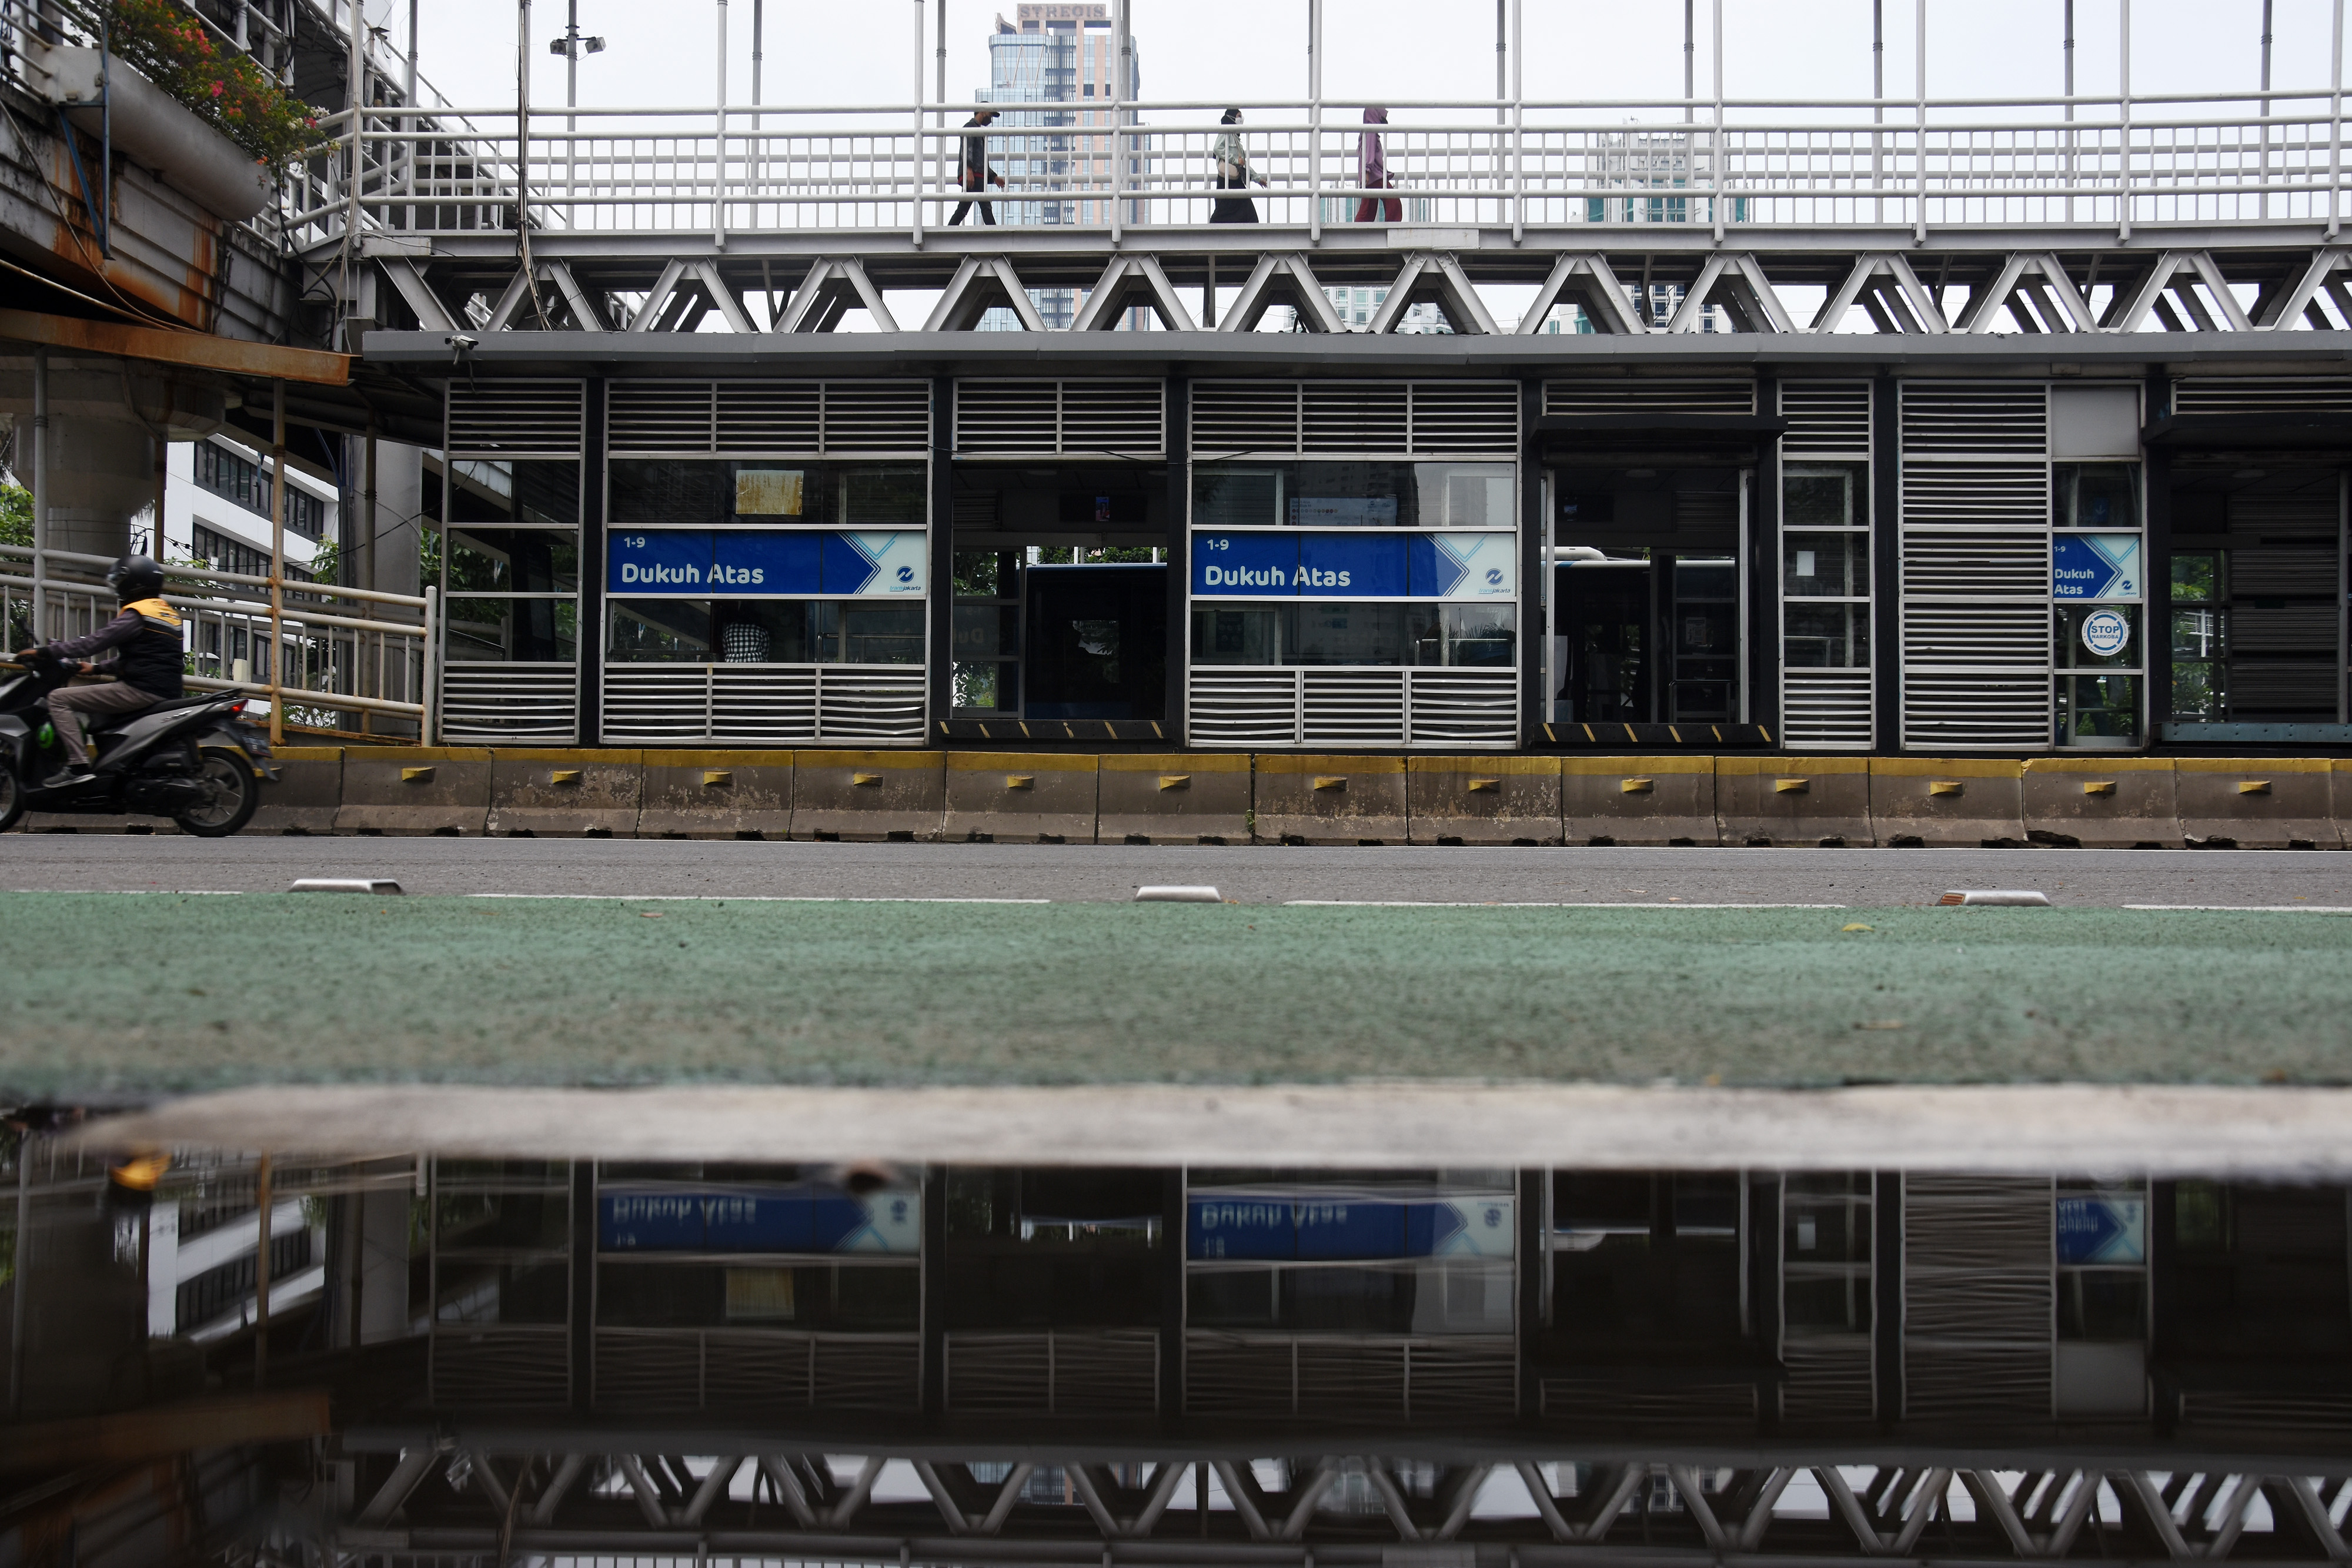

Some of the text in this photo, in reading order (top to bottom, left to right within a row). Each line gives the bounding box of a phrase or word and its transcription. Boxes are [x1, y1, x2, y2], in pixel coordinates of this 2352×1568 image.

[624, 537, 645, 547] 1-9
[1207, 539, 1229, 550] 1-9
[622, 563, 764, 584] Dukuh Atas
[1205, 566, 1351, 586] Dukuh Atas
[2054, 569, 2094, 579] Dukuh
[2054, 584, 2083, 594] Atas
